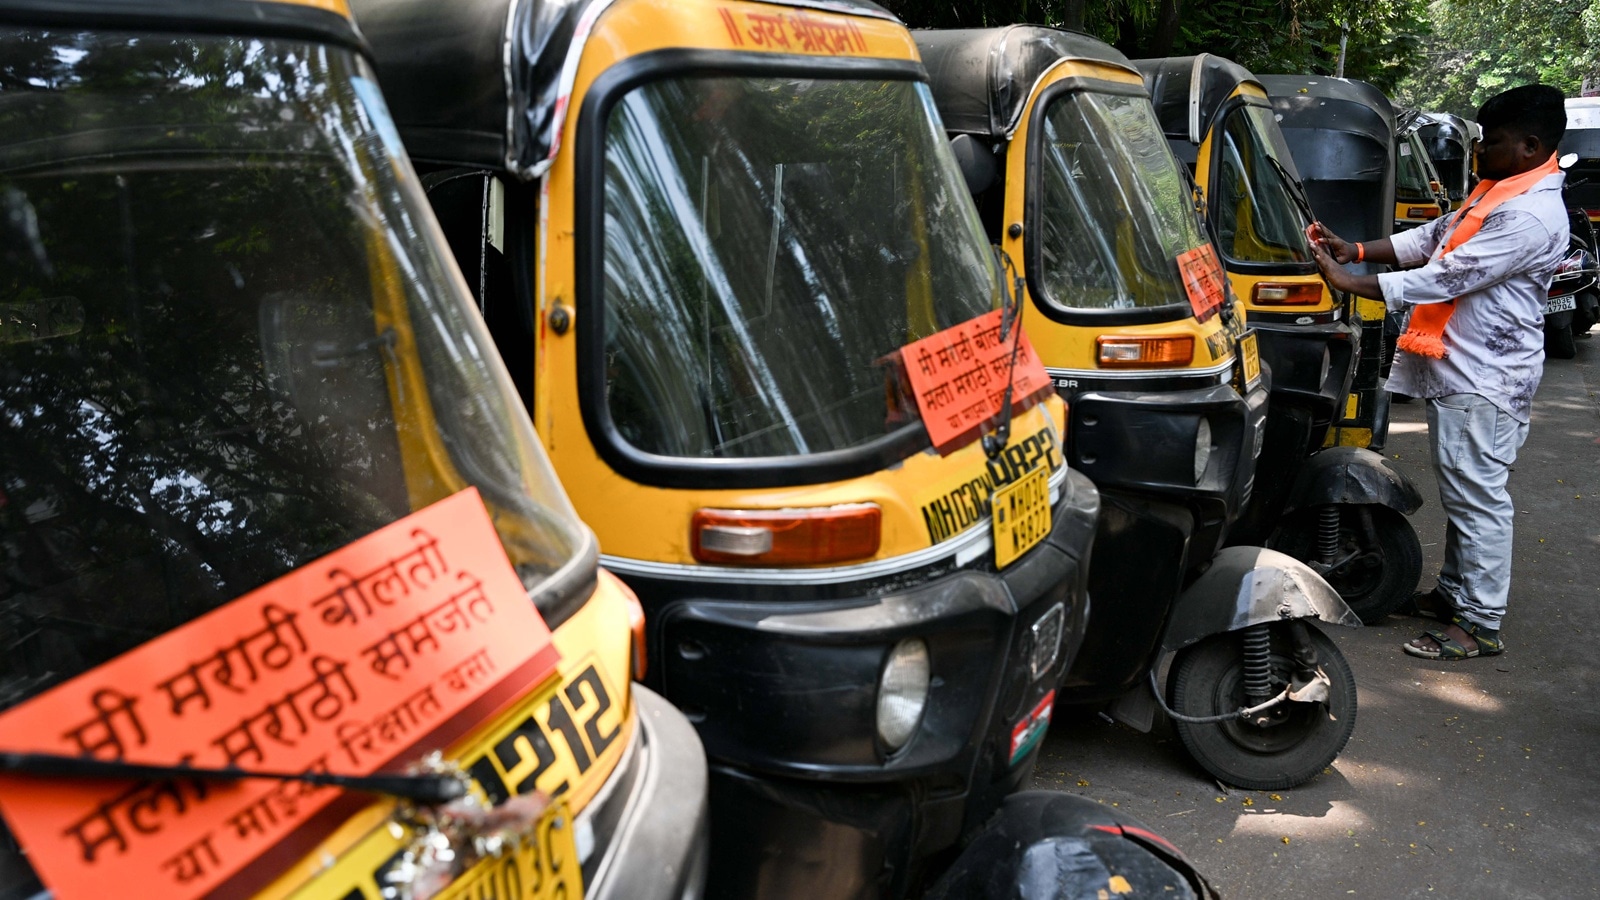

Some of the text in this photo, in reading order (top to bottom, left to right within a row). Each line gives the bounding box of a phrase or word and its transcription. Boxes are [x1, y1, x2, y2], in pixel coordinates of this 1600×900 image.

[746, 13, 790, 48] जय
[918, 347, 937, 376] मी
[936, 331, 975, 368] मराठी
[922, 382, 954, 410] मला
[952, 358, 992, 395] मराठी
[989, 345, 1030, 378] समते
[62, 527, 452, 760] मी मराठी बोलतो
[211, 653, 358, 772] मराठी
[361, 571, 497, 681] समजते
[159, 831, 221, 893] या
[336, 684, 443, 767] रिक्षात
